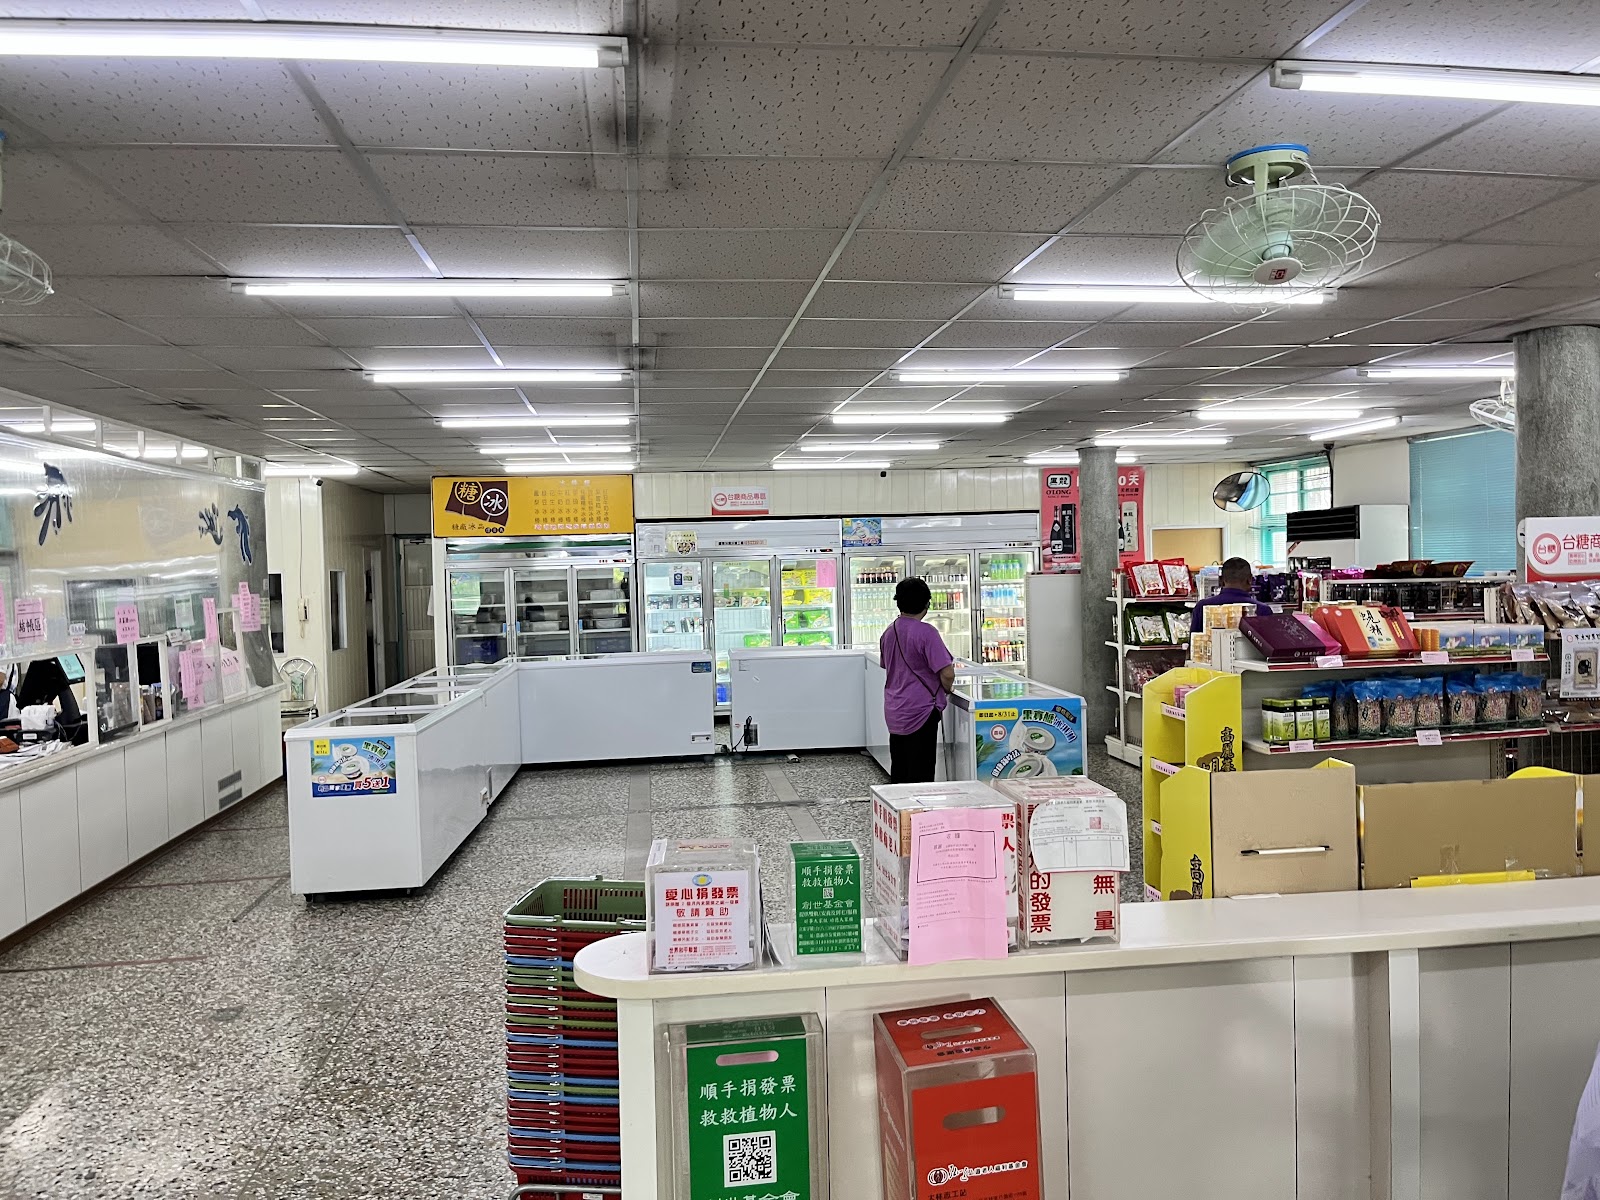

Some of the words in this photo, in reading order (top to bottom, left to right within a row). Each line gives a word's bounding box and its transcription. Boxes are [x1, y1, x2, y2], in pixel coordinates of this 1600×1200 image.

[458, 482, 478, 500] 糖
[484, 494, 503, 511] 冰
[728, 492, 766, 500] 台糖商品專區
[1538, 544, 1556, 554] 台糖
[801, 864, 854, 876] 順手捐發票
[801, 876, 854, 887] 救救植物人
[666, 887, 738, 900] 愛心捐發票
[802, 899, 854, 910] 創世基金會
[676, 908, 728, 917] 敬請贊助
[700, 1075, 796, 1100] 順手捐發票
[700, 1103, 797, 1126] 救救植物人
